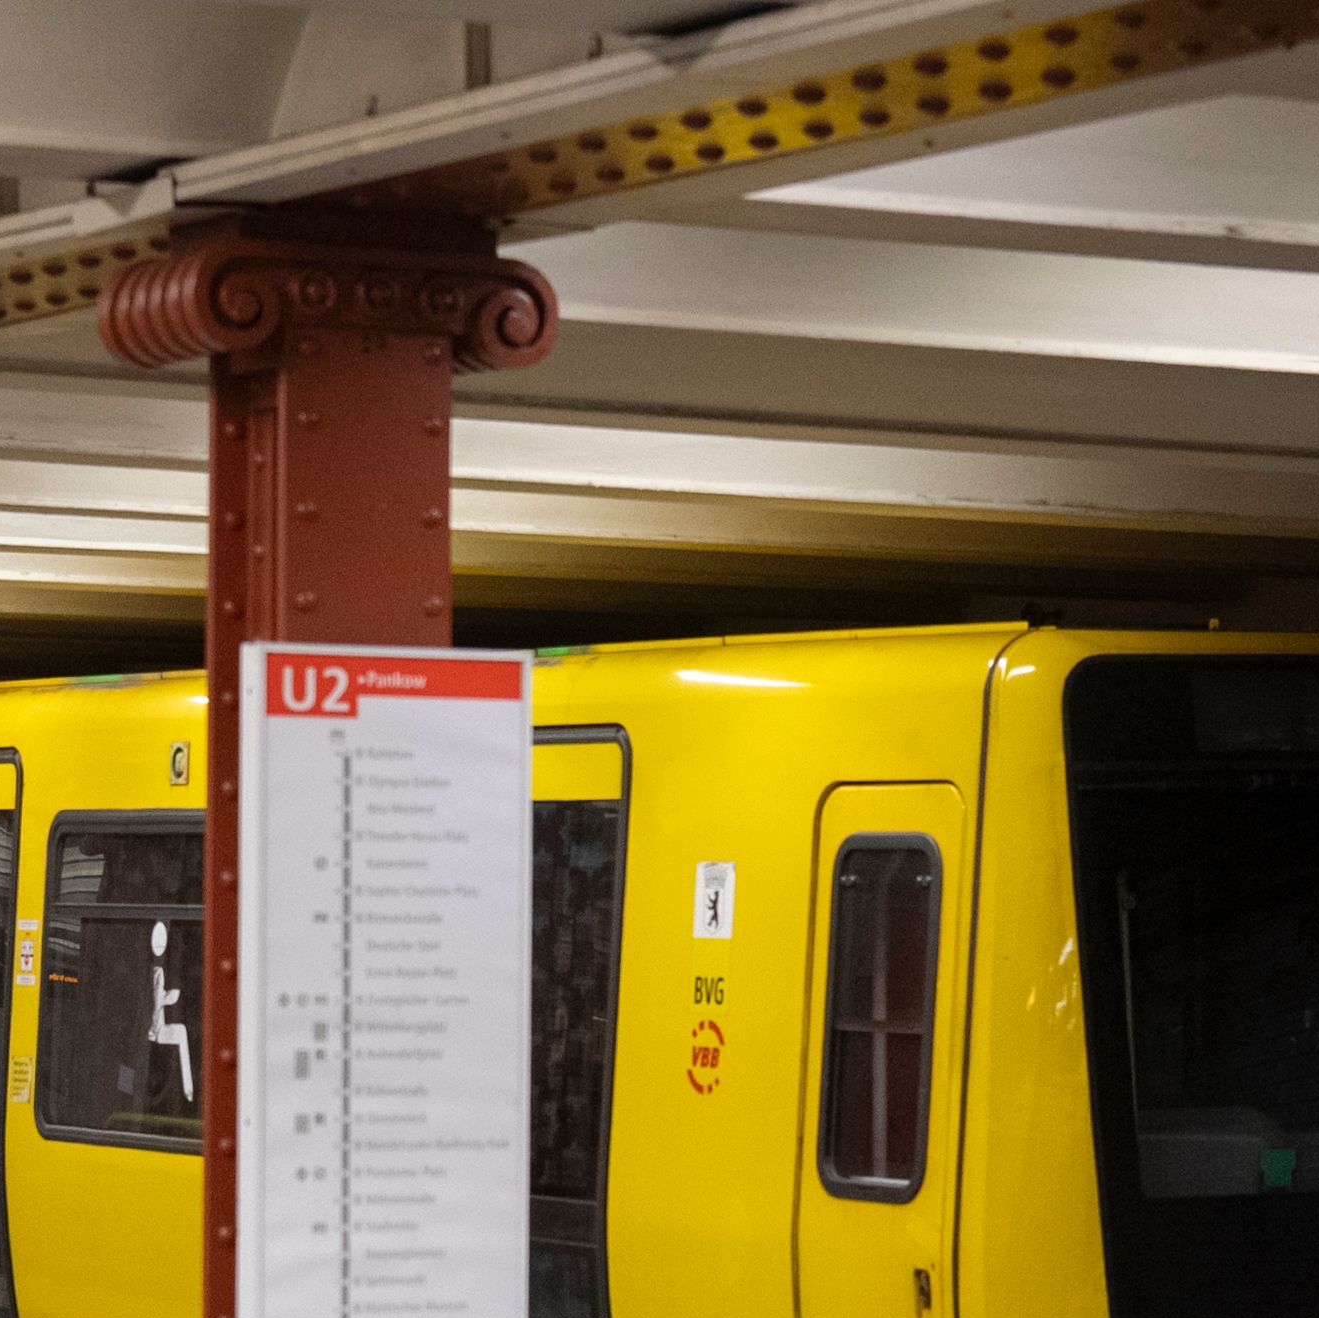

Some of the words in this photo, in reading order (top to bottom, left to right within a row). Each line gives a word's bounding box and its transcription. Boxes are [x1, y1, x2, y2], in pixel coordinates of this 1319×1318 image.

[282, 665, 350, 712] U2
[693, 976, 724, 1005] BVG
[692, 1046, 720, 1069] VBB
